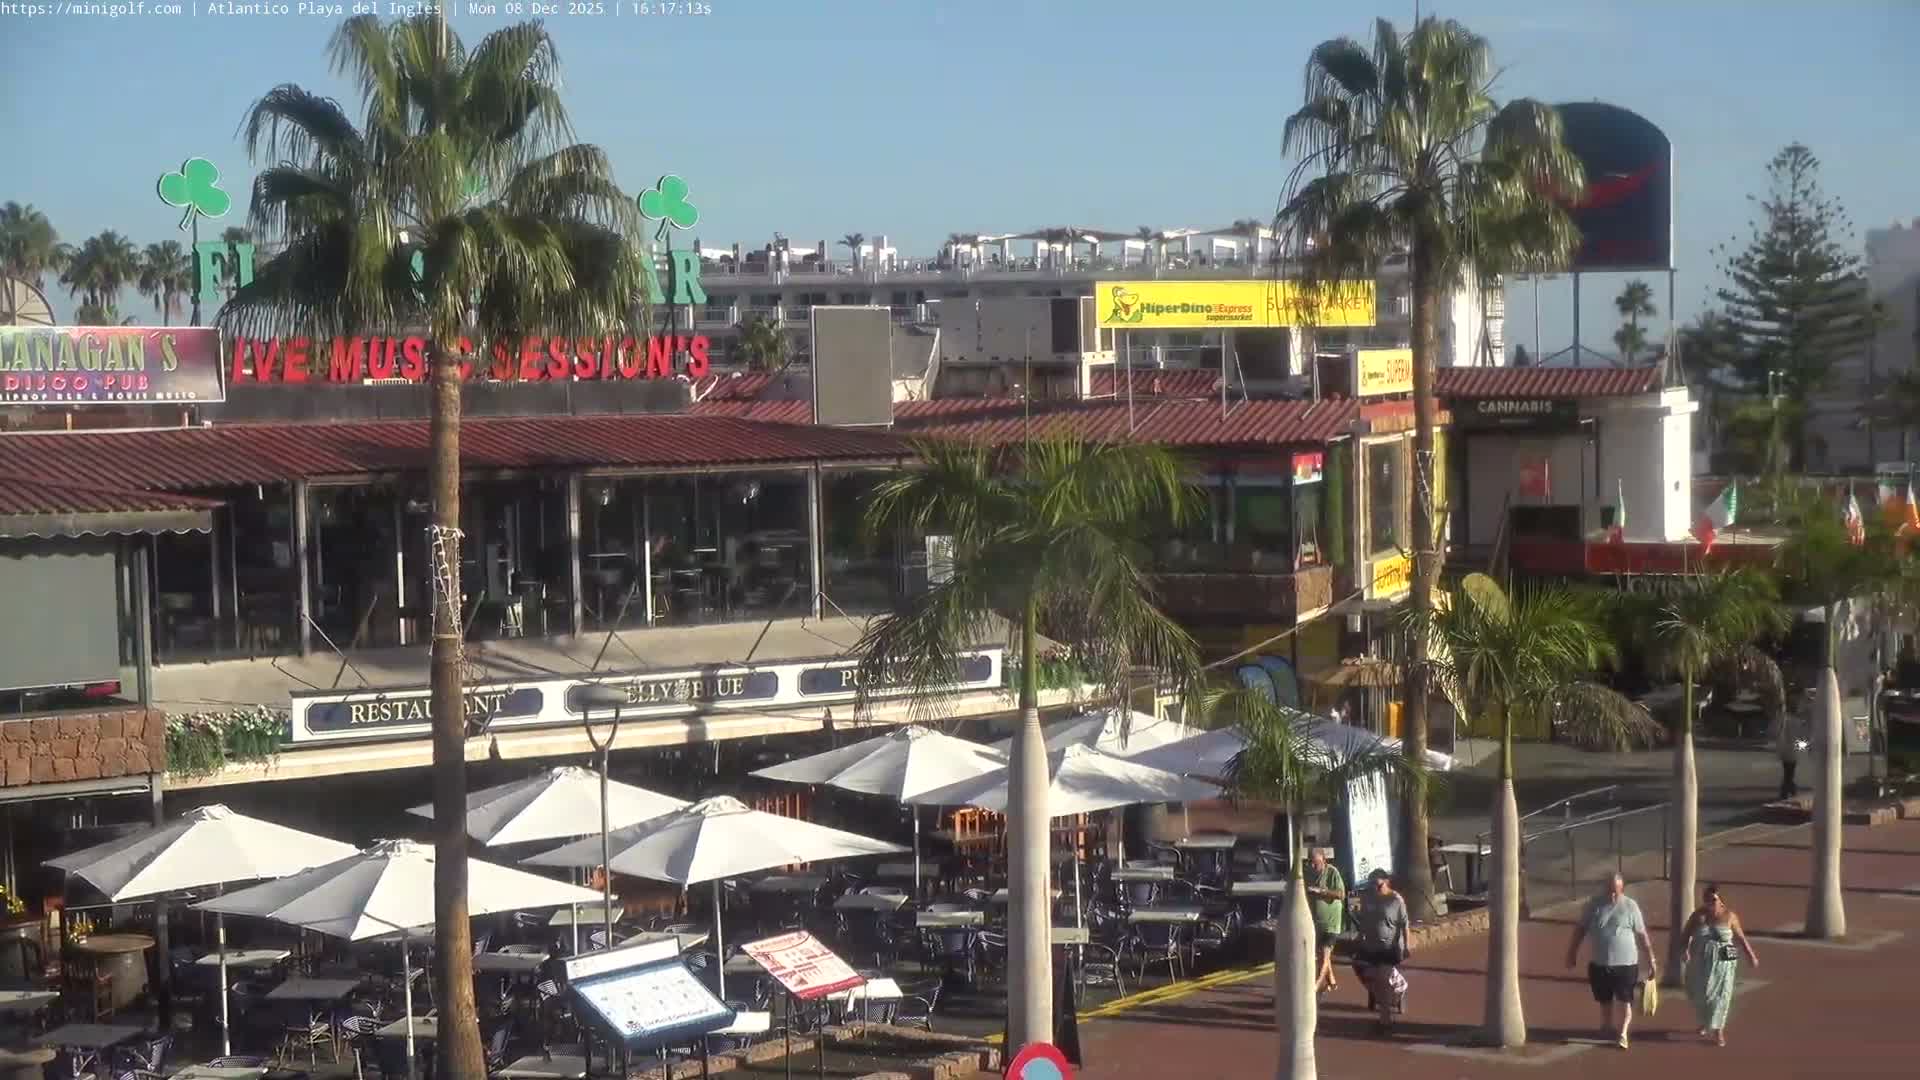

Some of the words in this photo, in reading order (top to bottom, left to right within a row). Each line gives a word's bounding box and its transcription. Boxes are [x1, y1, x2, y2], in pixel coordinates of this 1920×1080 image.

[1140, 303, 1212, 315] HiperDino
[1219, 304, 1253, 313] Express
[231, 336, 310, 384] IVE
[330, 336, 475, 384] MUSC
[103, 374, 149, 390] PUB
[1478, 401, 1553, 413] CANNABIS
[351, 694, 506, 724] RESTAUNT
[625, 681, 672, 703] ELLY
